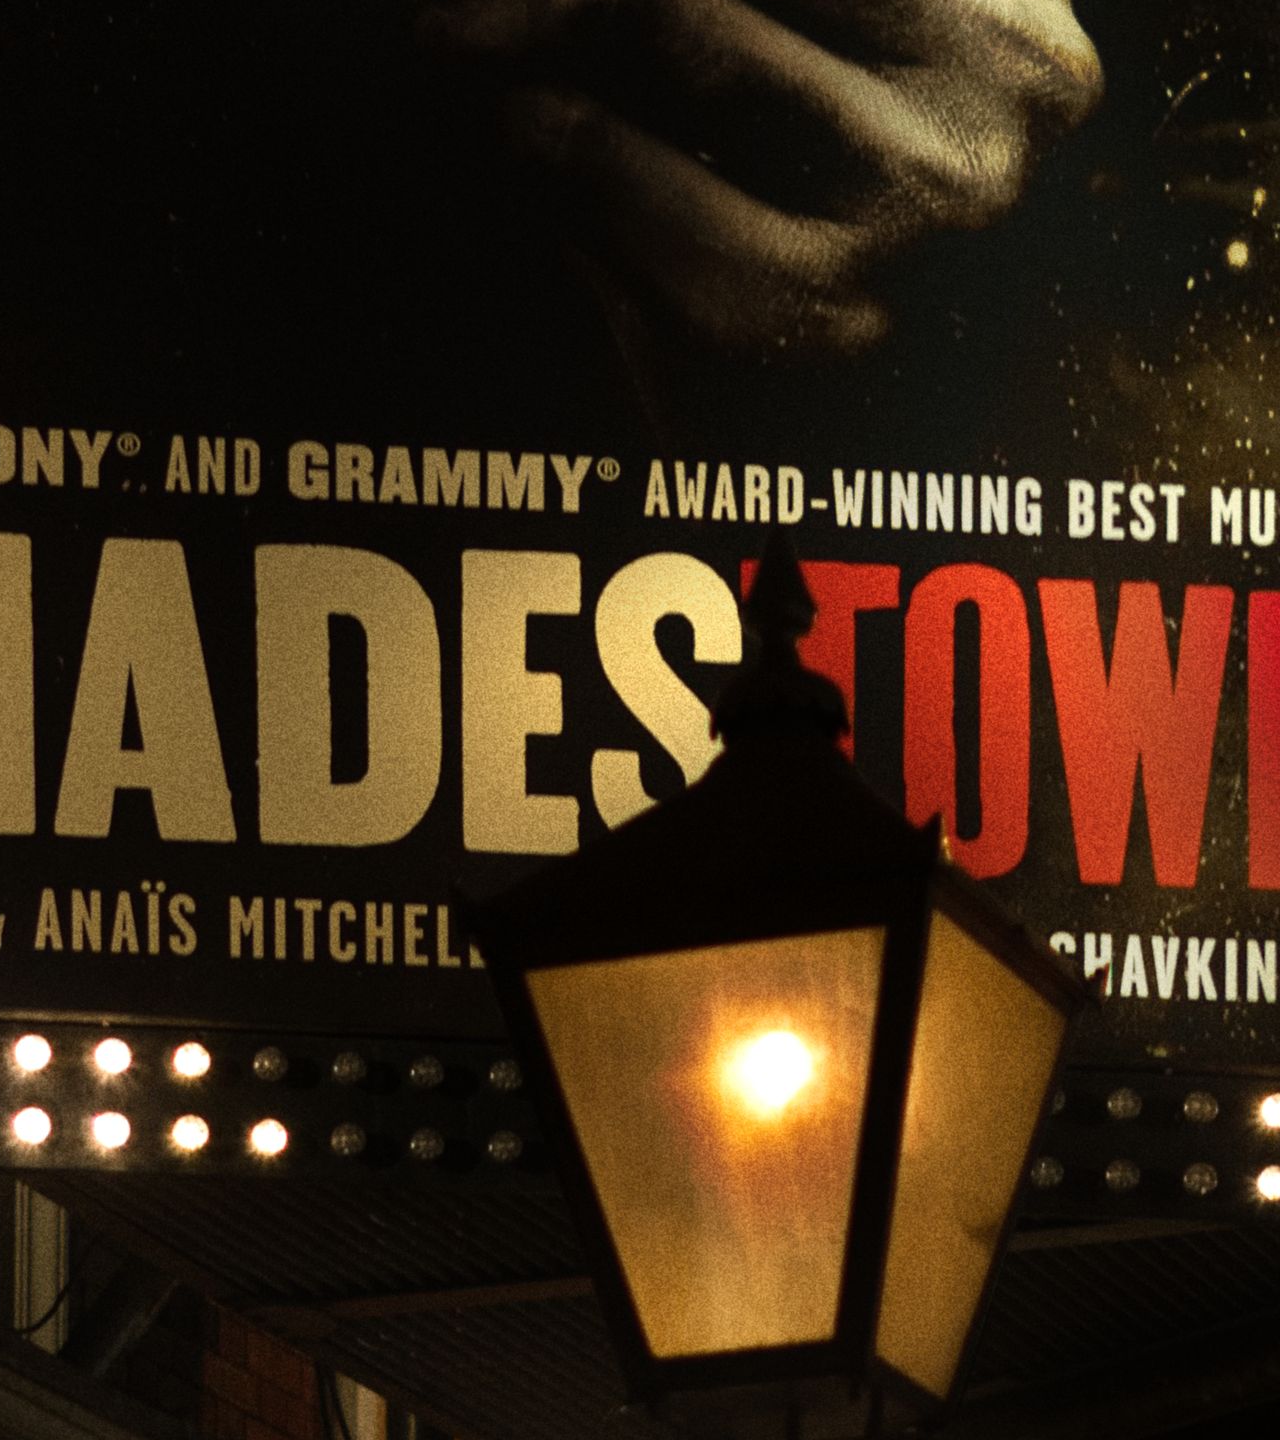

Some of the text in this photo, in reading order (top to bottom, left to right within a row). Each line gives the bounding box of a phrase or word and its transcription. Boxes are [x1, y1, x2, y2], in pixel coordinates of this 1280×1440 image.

[164, 434, 262, 497] AND
[643, 458, 1043, 538] AWARD-WINNING
[1068, 478, 1187, 545] BEST
[33, 878, 200, 958] ANAÏS
[228, 894, 488, 970] MITCHEL
